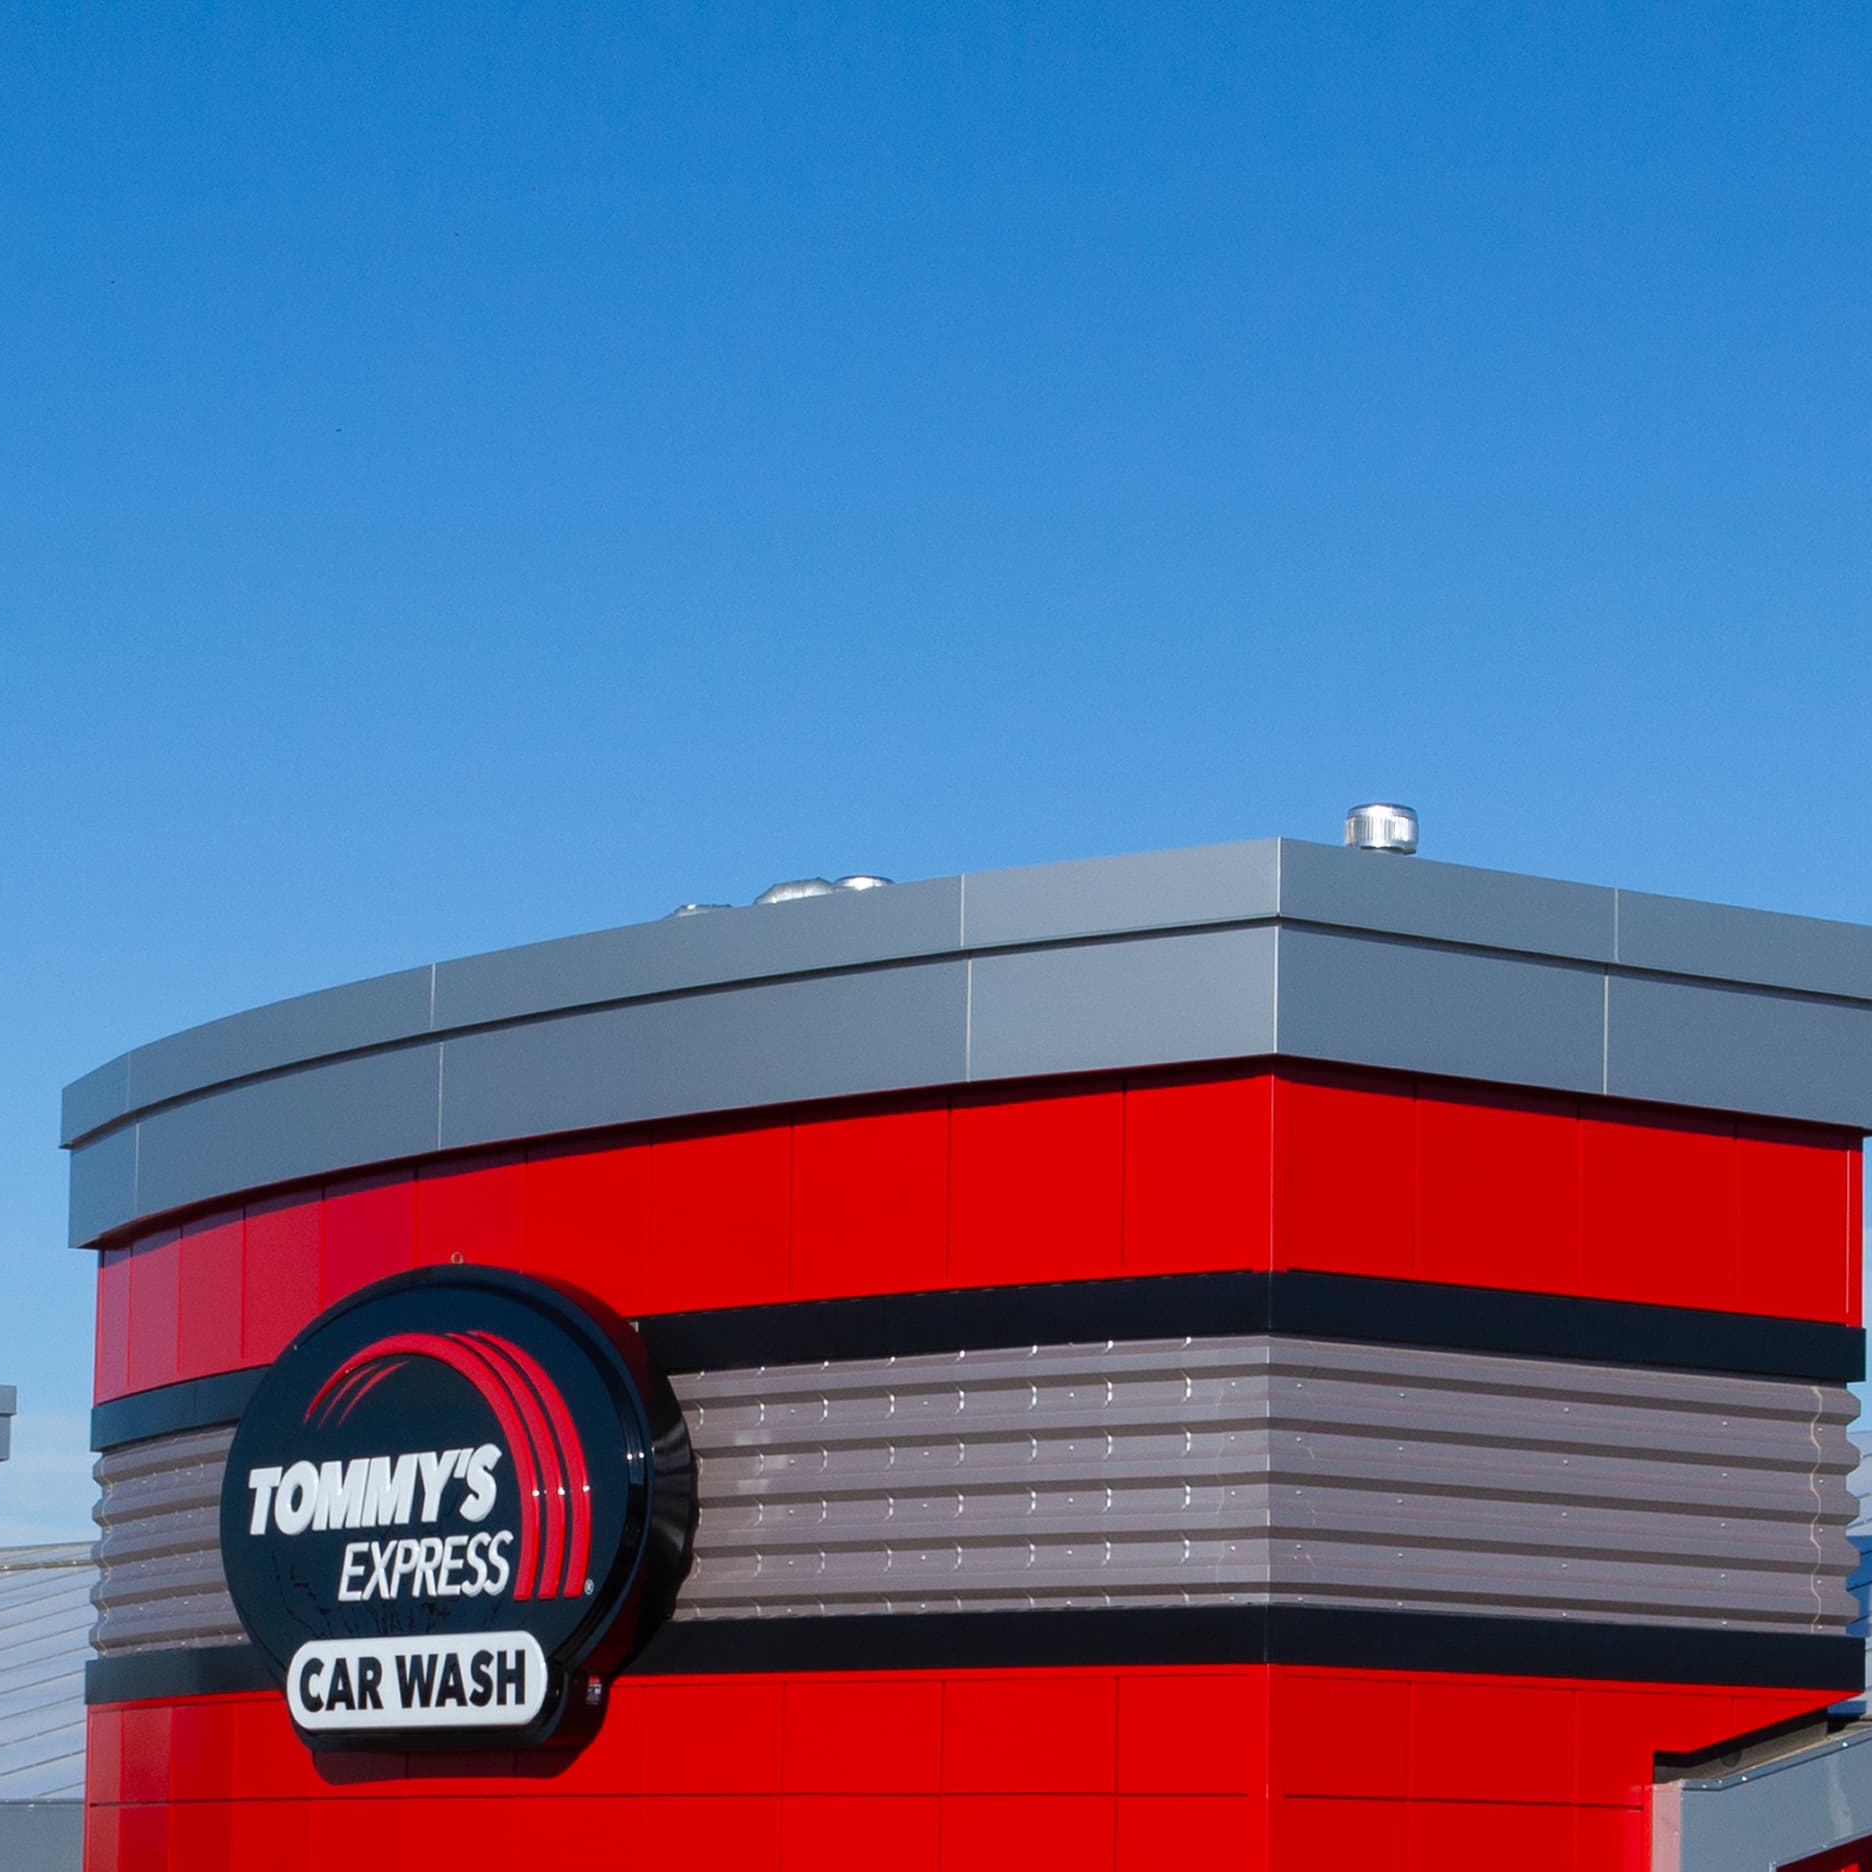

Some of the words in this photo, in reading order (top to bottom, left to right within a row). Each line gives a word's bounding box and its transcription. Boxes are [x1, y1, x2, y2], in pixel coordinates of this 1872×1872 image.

[248, 1443, 502, 1536] TOMMY'S
[338, 1530, 514, 1601] EXPRESS
[299, 1656, 384, 1713] CAR
[394, 1649, 526, 1709] WASH
